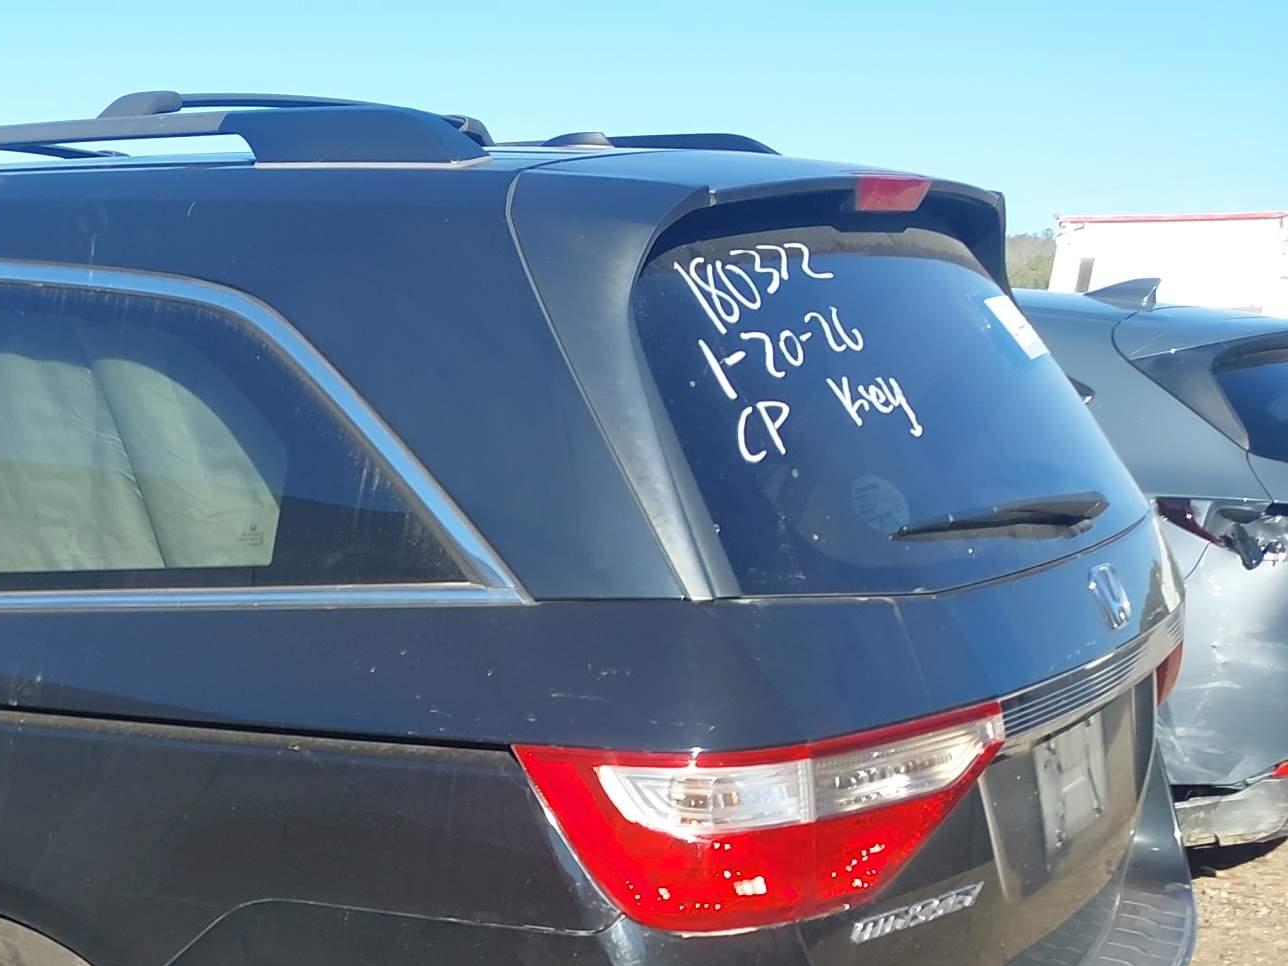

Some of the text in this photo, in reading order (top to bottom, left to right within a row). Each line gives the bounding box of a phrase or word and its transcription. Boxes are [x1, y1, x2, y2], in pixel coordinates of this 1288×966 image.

[673, 242, 834, 335] 180372
[698, 306, 864, 400] 1-20-26
[737, 400, 790, 463] CP
